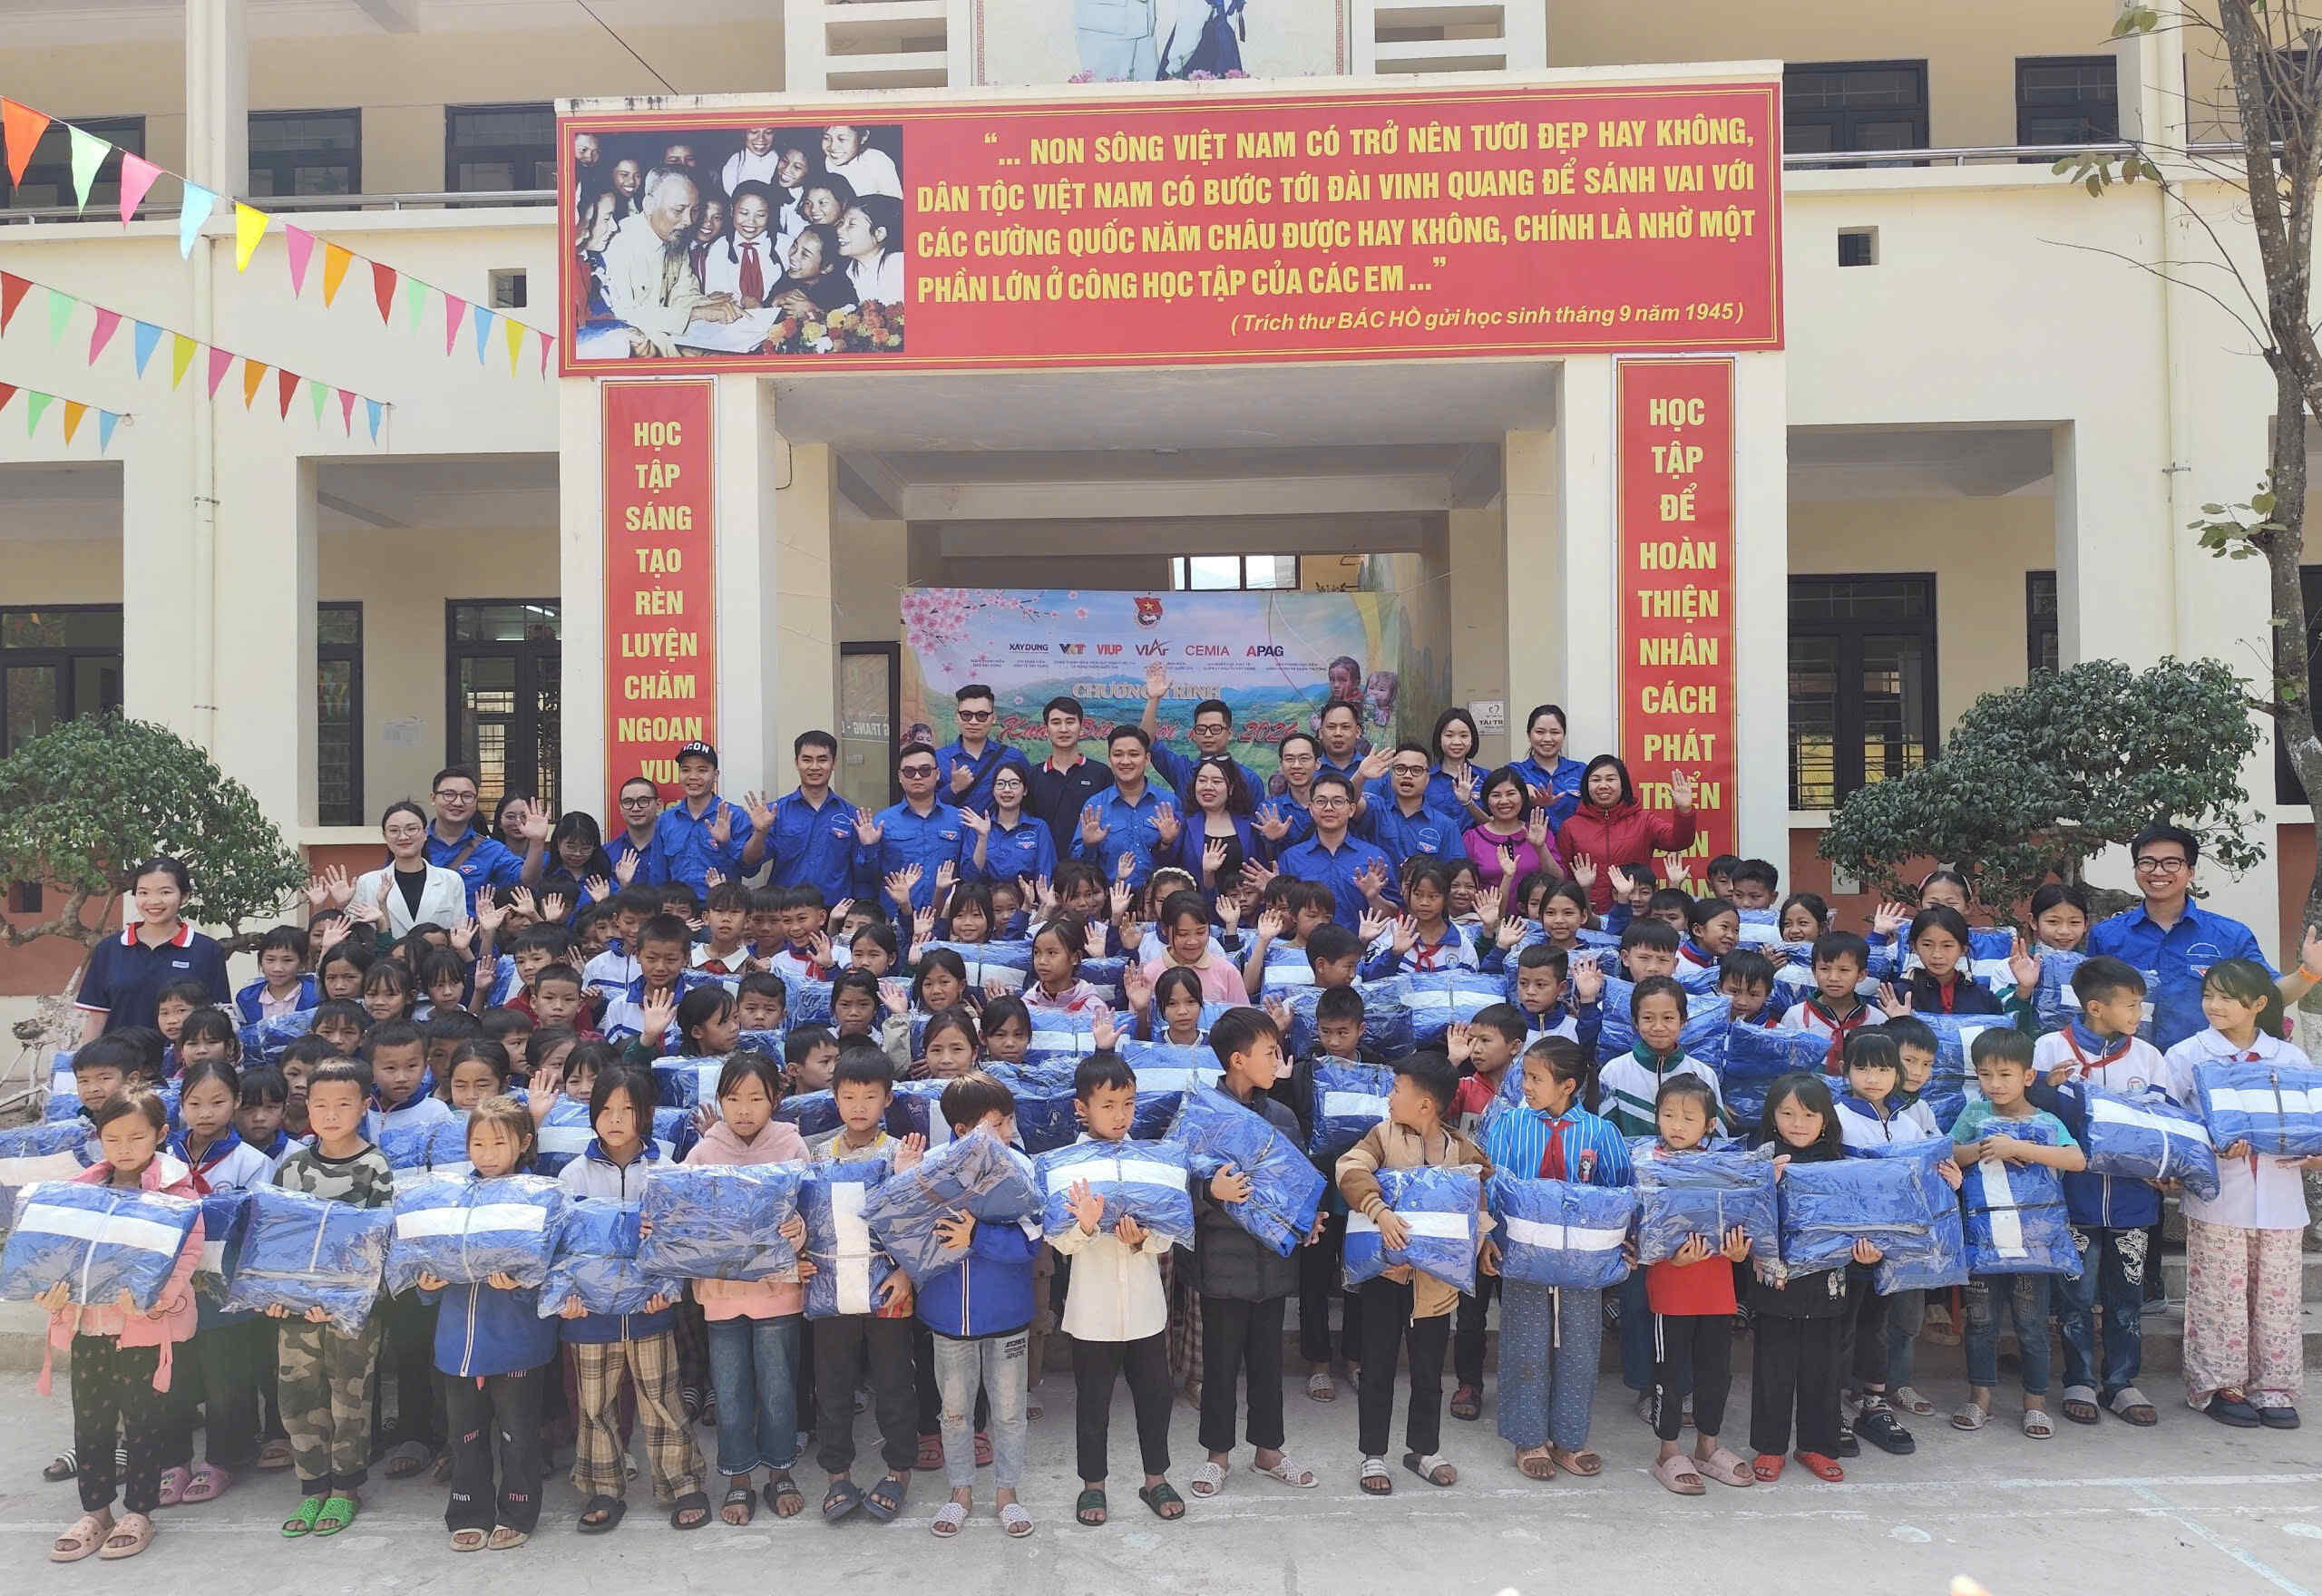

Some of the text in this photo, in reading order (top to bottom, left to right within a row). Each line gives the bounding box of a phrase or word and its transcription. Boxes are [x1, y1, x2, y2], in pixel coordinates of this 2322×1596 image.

[1031, 138, 1084, 164] NON
[1095, 131, 1164, 162] SÔNG
[1173, 129, 1226, 166] VIỆT
[1237, 131, 1295, 159] NAM
[1307, 124, 1340, 156] CÓ
[1350, 120, 1399, 155] TRỞ
[1409, 121, 1460, 153] NÊN
[1470, 121, 1527, 151] TƯƠI
[1537, 122, 1588, 154] ĐẸP
[1598, 121, 1646, 147] HAY
[1657, 113, 1753, 147] KHÔNG,
[917, 157, 1753, 216] DÂN TỘC VIỆT NAM CÓ BƯỚC TỚI ĐÀI VINH QUANG ĐỂ SÁNH VAI VỚI
[918, 205, 1755, 258] CÁC CƯỜNG QUỐC NĂM CHÂU ĐƯỢC HAY KHÔNG, CHÍNH LÀ NHỜ MỘT
[918, 267, 987, 303] PHẦN
[992, 269, 1040, 301] LỚN
[1047, 266, 1063, 300] Ở
[1068, 268, 1137, 300] CÔNG
[1143, 271, 1193, 303] HỌC
[1198, 265, 1245, 302] TẬP
[1253, 259, 1302, 295] CỦA
[1309, 261, 1359, 293] CÁC
[1364, 265, 1403, 292] EM
[1299, 313, 1335, 329] thư
[1338, 307, 1385, 328] BÁC
[1389, 307, 1420, 326] HỒ
[1425, 308, 1460, 330] gửi
[1464, 308, 1502, 328] học
[1507, 307, 1550, 324] sinh
[1556, 306, 1615, 326] tháng
[1620, 305, 1631, 321] 9
[1635, 305, 1680, 321] năm
[1650, 398, 1704, 432] HỌC
[633, 422, 681, 452] HỌC
[635, 459, 680, 493] TẬP
[1650, 441, 1704, 479] TẬP
[625, 501, 692, 530] SÁNG
[1660, 482, 1699, 521] ĐỂ
[635, 548, 682, 578] TẠO
[1640, 536, 1716, 569] HOÀN
[635, 586, 684, 615] RÈN
[1638, 584, 1718, 623] THIỆN
[621, 628, 698, 662] LUYỆN
[1097, 643, 1123, 655] VIUP
[1185, 645, 1230, 657] CEMIA
[1246, 645, 1284, 657] APAG
[1640, 632, 1718, 666] NHÂN
[624, 669, 696, 699] CHĂM
[1642, 680, 1715, 714] CÁCH
[618, 717, 703, 742] NGOAN
[1644, 728, 1715, 761] PHÁT
[1639, 770, 1720, 809] TRỂN
